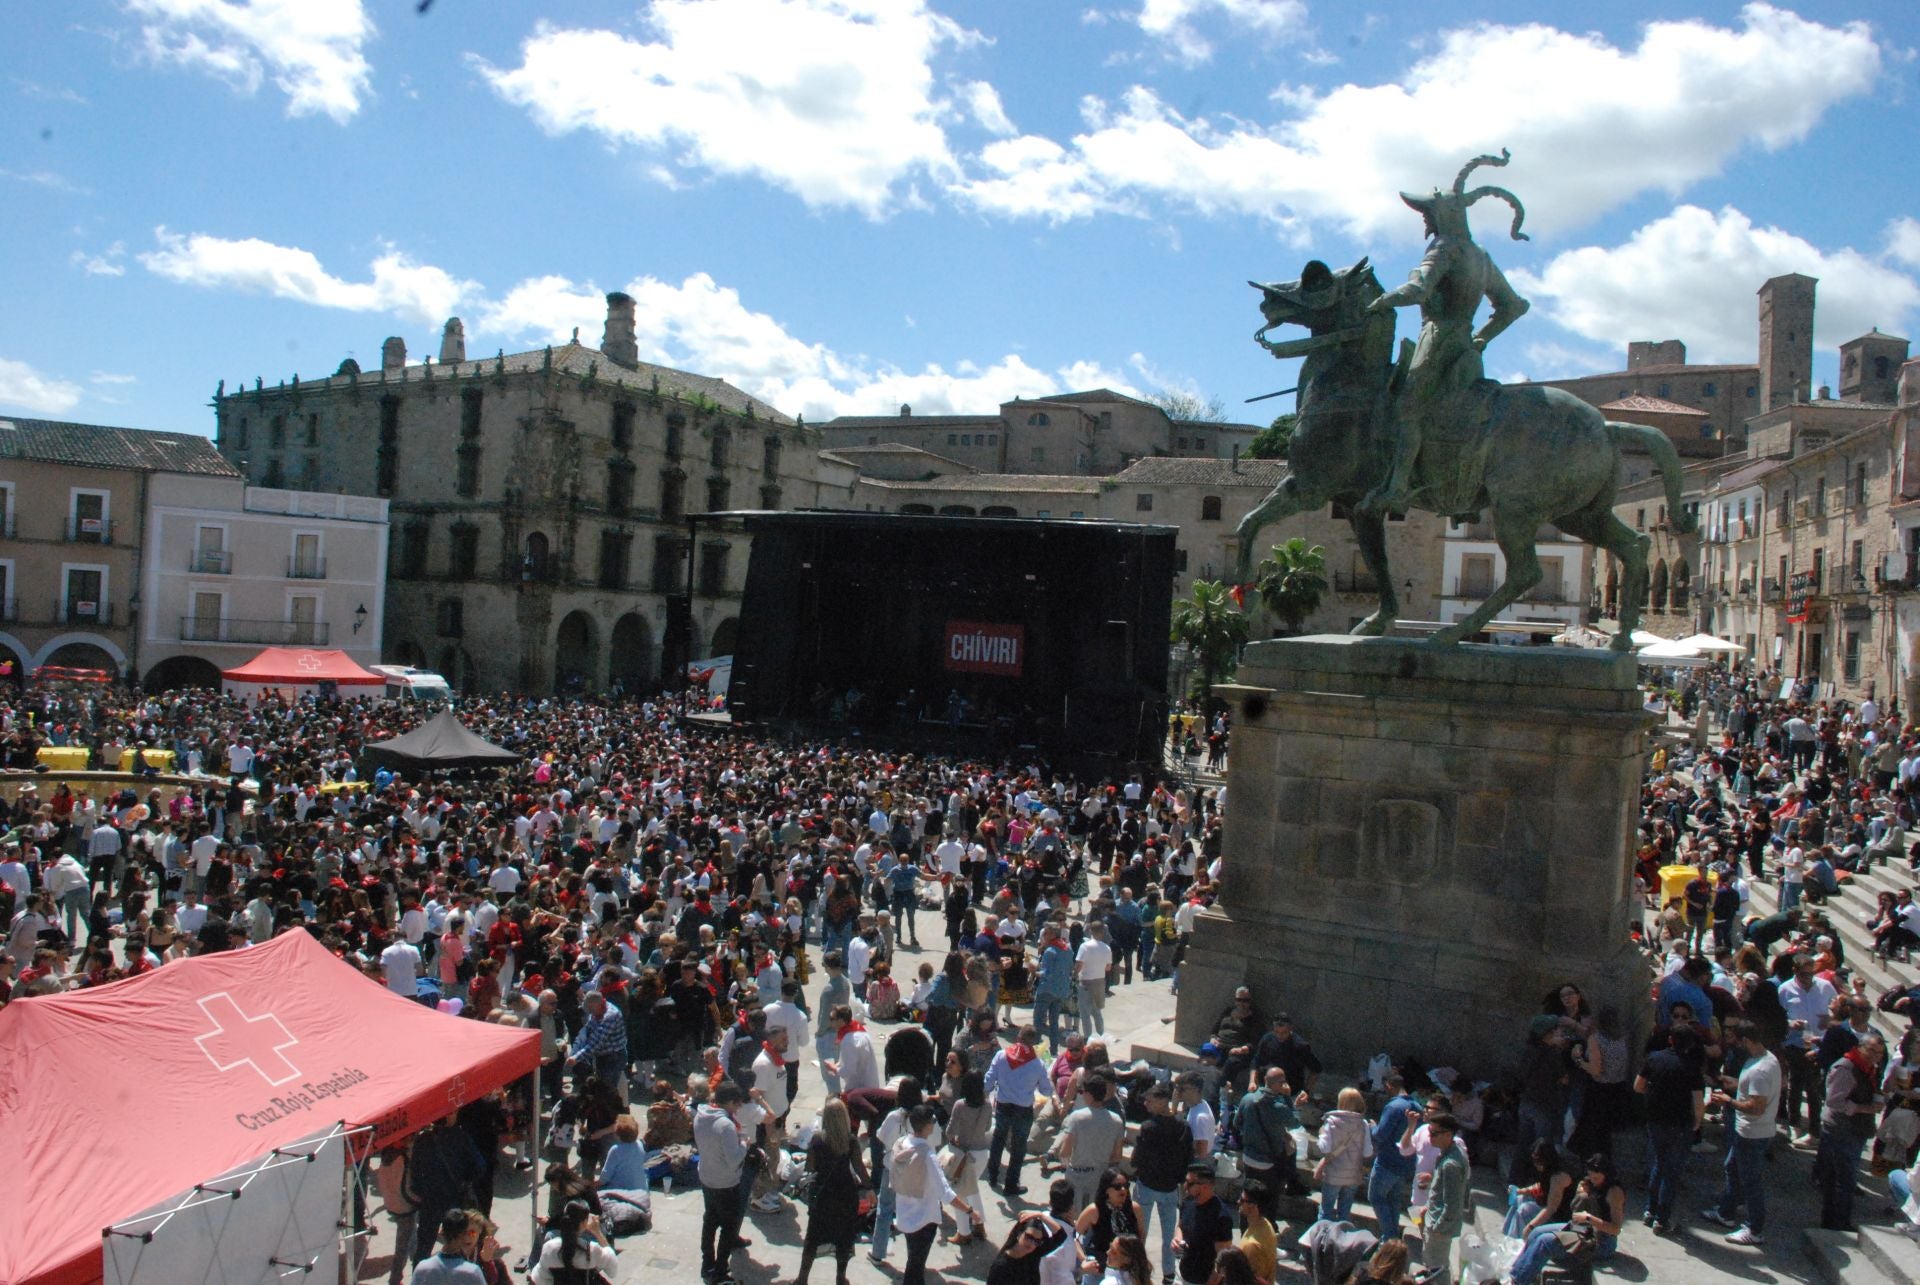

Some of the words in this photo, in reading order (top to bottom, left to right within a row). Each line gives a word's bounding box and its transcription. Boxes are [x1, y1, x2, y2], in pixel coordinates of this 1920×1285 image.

[951, 630, 1017, 664] CHÍVIRI
[236, 1107, 283, 1130] Cruz
[270, 1091, 315, 1112] Roja
[302, 1067, 370, 1098] Española
